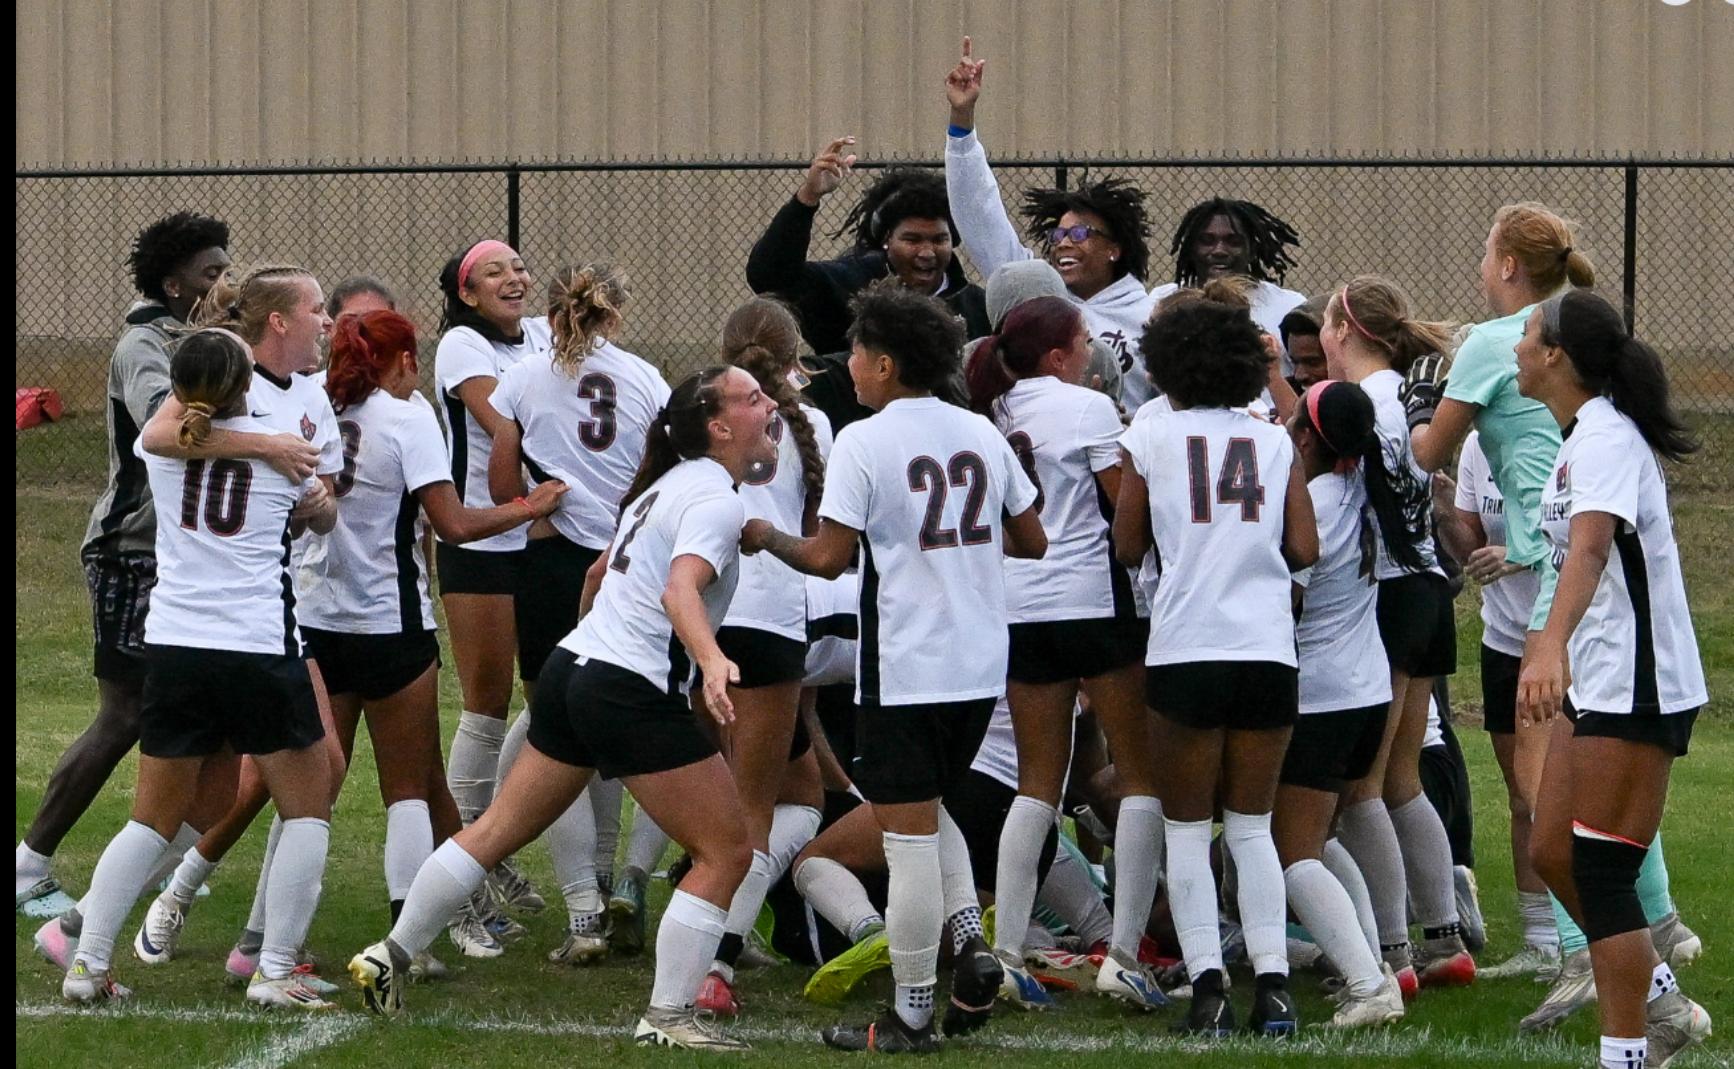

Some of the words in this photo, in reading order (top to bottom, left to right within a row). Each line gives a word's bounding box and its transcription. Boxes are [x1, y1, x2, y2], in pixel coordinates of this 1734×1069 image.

[576, 371, 617, 453] 3
[179, 457, 253, 538] 10
[907, 450, 992, 551] 22
[1186, 435, 1265, 524] 14
[1482, 496, 1504, 515] TRIN
[1542, 502, 1566, 521] LLEY
